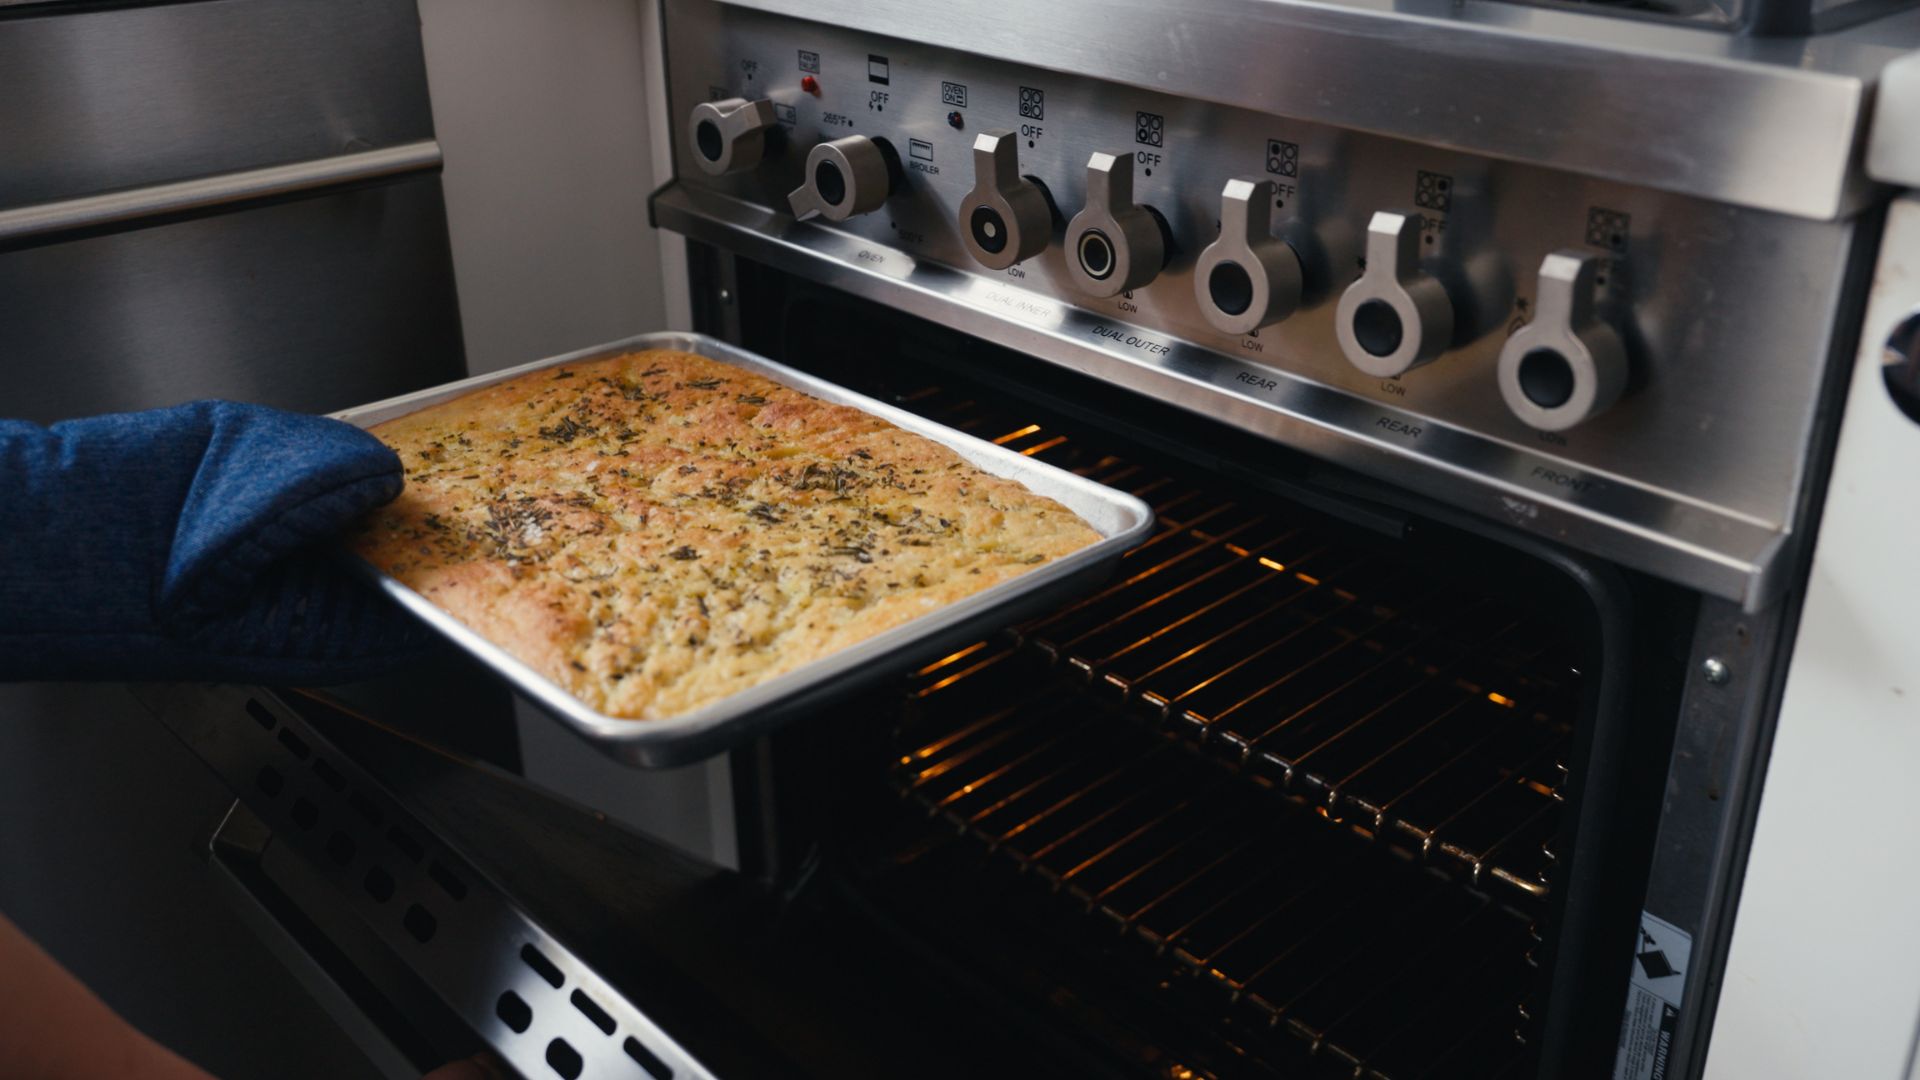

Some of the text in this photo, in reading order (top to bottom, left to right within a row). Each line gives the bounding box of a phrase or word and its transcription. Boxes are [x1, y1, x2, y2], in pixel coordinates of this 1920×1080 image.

[870, 91, 889, 104] OFF
[944, 85, 964, 96] OVEN
[945, 93, 956, 102] ON
[1020, 123, 1043, 140] OFF
[909, 160, 940, 175] BROILER
[1137, 151, 1162, 168] OFF
[858, 250, 886, 264] OVEN
[1007, 266, 1026, 280] LOW
[985, 290, 1052, 319] DUAL INNER
[1117, 300, 1138, 315] LOW
[1092, 324, 1171, 357] DUAL OUTER
[1241, 339, 1264, 353] LOW
[1235, 370, 1278, 393] REAR
[1380, 381, 1407, 398] LOW
[1375, 416, 1423, 440] REAR
[1531, 465, 1593, 493] FRONT
[1653, 1030, 1670, 1080] WARNING
